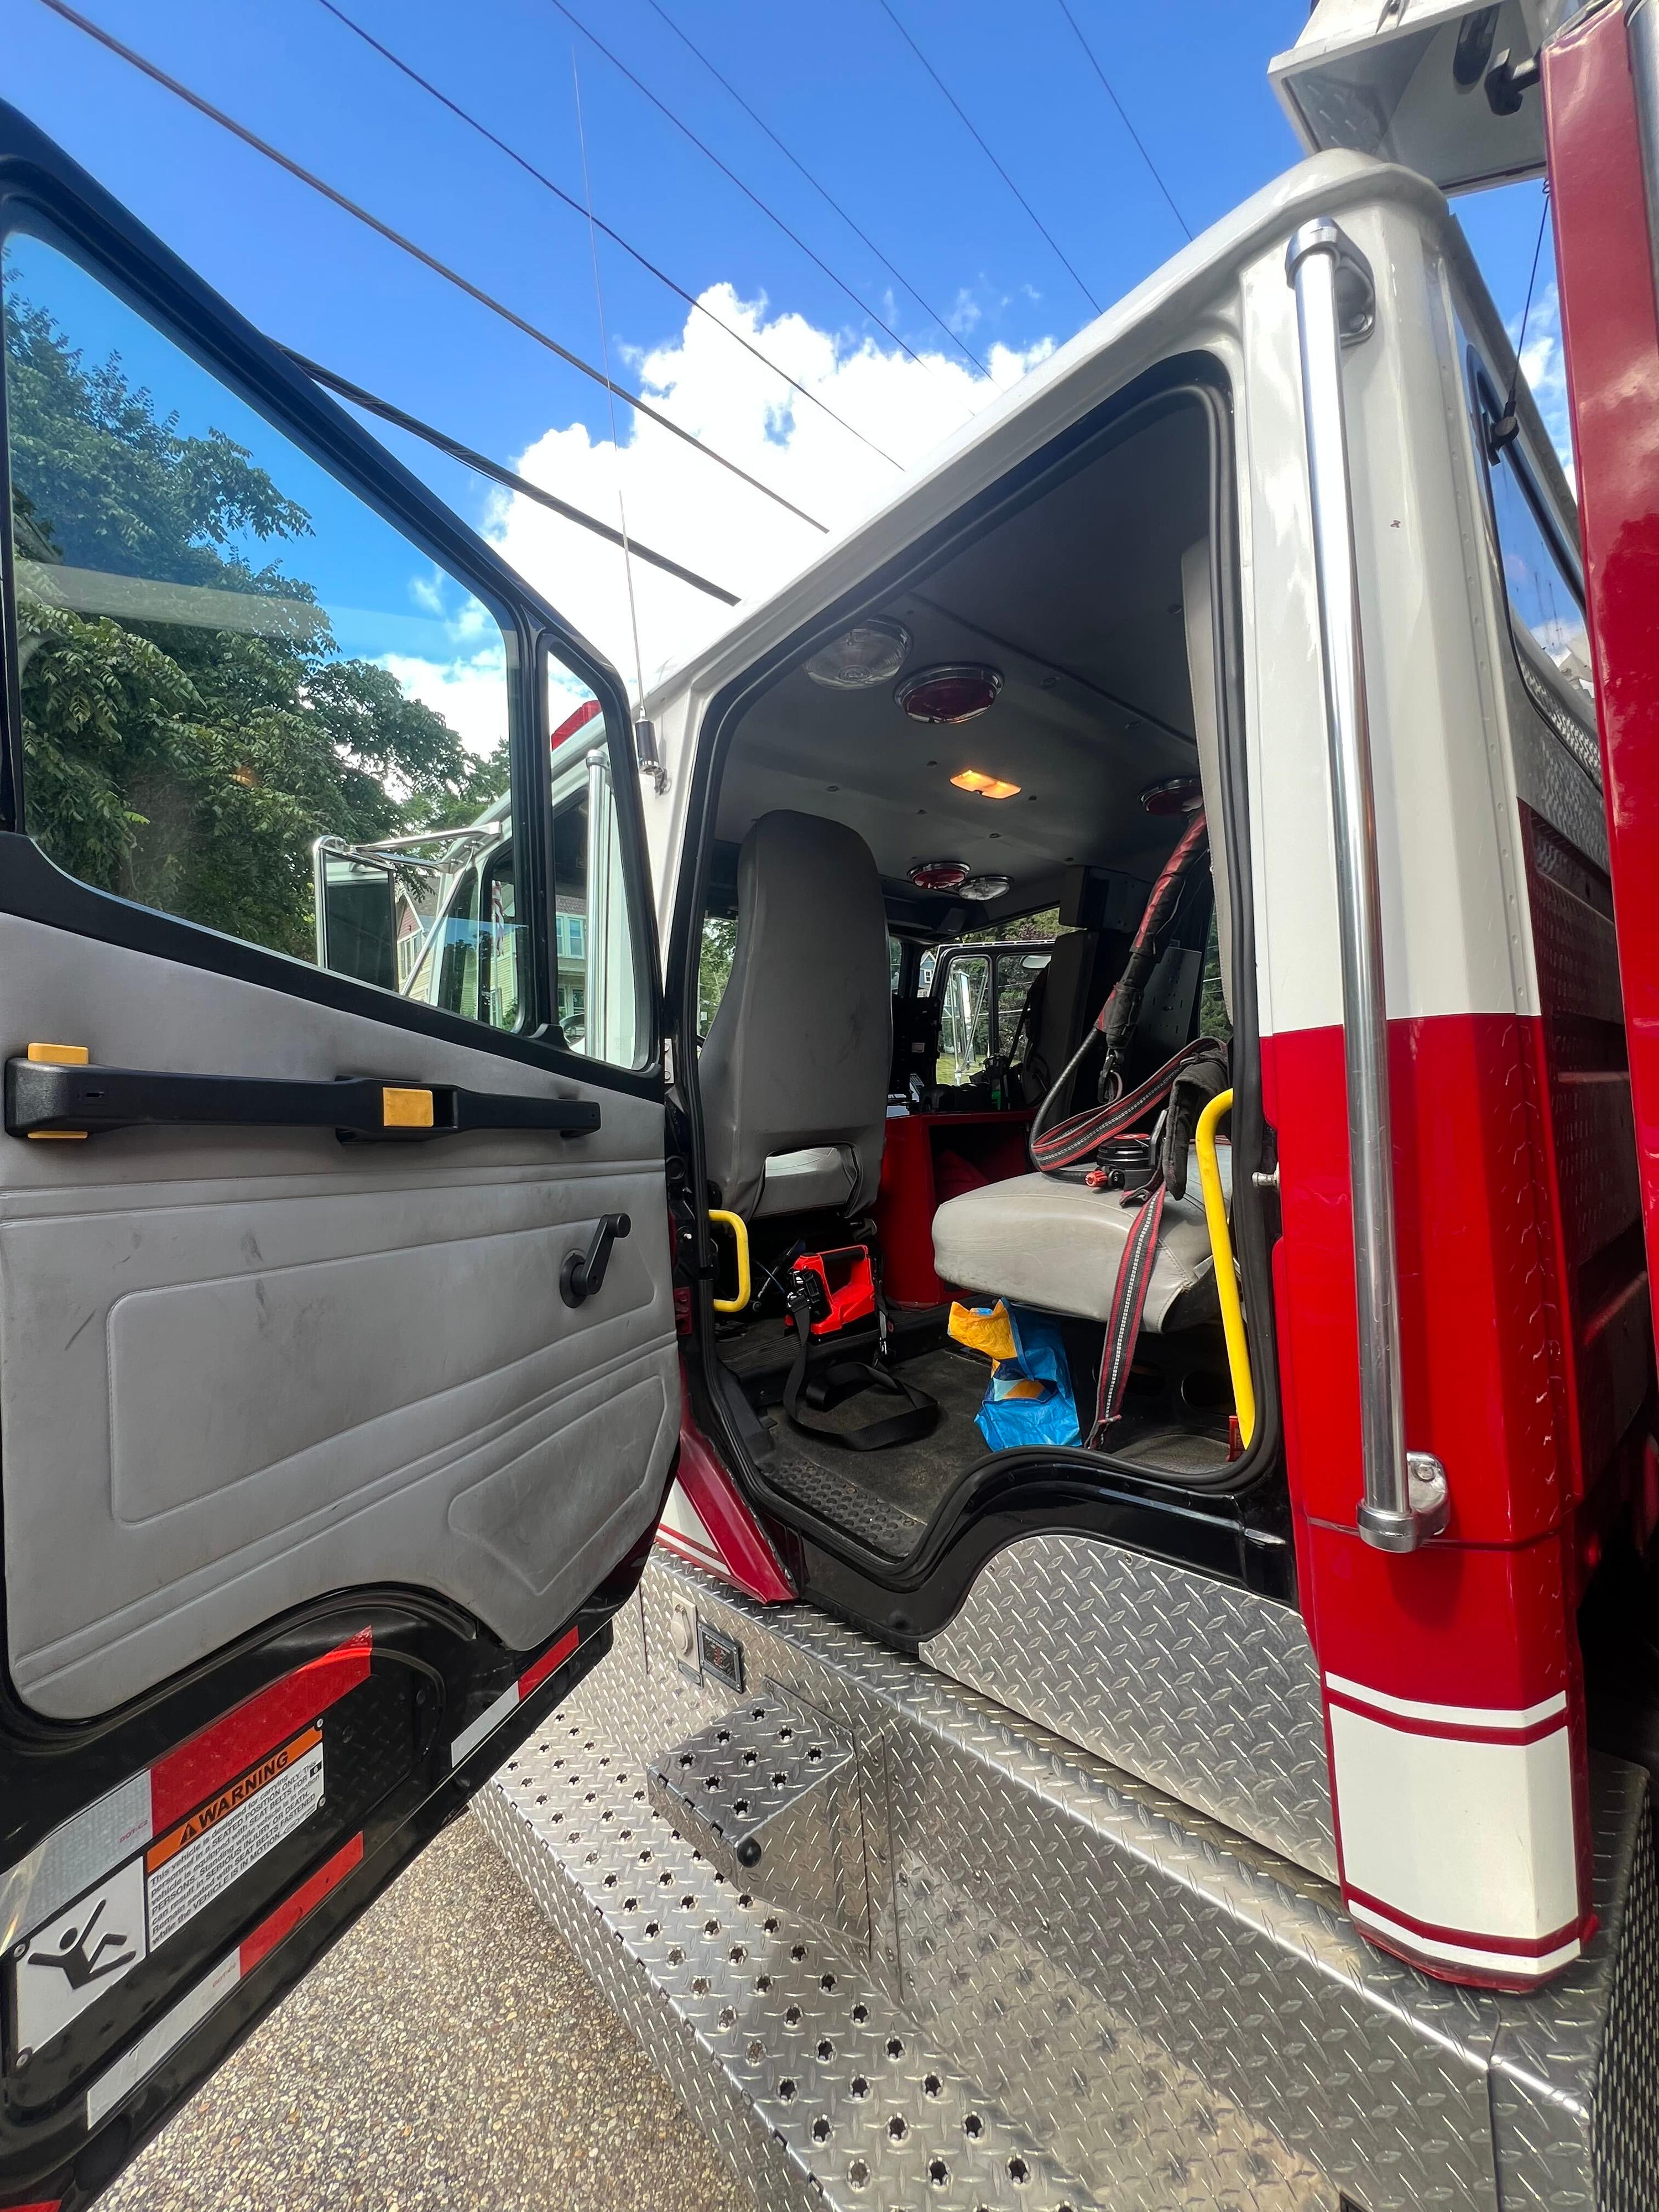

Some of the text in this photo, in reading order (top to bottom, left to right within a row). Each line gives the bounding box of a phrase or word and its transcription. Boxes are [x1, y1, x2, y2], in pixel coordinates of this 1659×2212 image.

[119, 1819, 148, 1843] DOT-C2
[150, 1774, 288, 1887] This vehicle is designed for carrying
[151, 1855, 194, 1899] personnel
[195, 1850, 203, 1861] in
[205, 1845, 210, 1854] a
[212, 1818, 243, 1848] SEATED
[245, 1788, 280, 1822] POSITION
[302, 1760, 316, 1773] This
[151, 1877, 182, 1906] vehicle
[184, 1870, 191, 1880] is
[193, 1837, 230, 1872] equipped
[231, 1824, 248, 1840] with
[249, 1806, 268, 1827] SEAT
[270, 1787, 292, 1811] BELTS
[293, 1775, 307, 1791] FOR
[199, 1751, 288, 1829] WARNING
[199, 1844, 234, 1877] Standing
[236, 1827, 255, 1846] while
[257, 1806, 281, 1829] vehicle
[283, 1800, 289, 1808] is
[290, 1793, 296, 1802] in
[298, 1774, 320, 1796] motion
[152, 1908, 168, 1926] can
[170, 1885, 195, 1912] result
[196, 1879, 204, 1889] in
[206, 1846, 242, 1881] SERIOUS
[243, 1822, 271, 1849] INJURY
[272, 1811, 284, 1824] OR
[285, 1791, 310, 1814] DEATH.
[152, 1903, 185, 1937] Remain
[187, 1877, 215, 1907] seated
[216, 1864, 233, 1881] with
[234, 1844, 254, 1866] SEAT
[256, 1824, 279, 1848] BELTS
[280, 1793, 315, 1827] FASTENED
[152, 1832, 281, 1945] while the VEHICLE IS IN MOTION.
